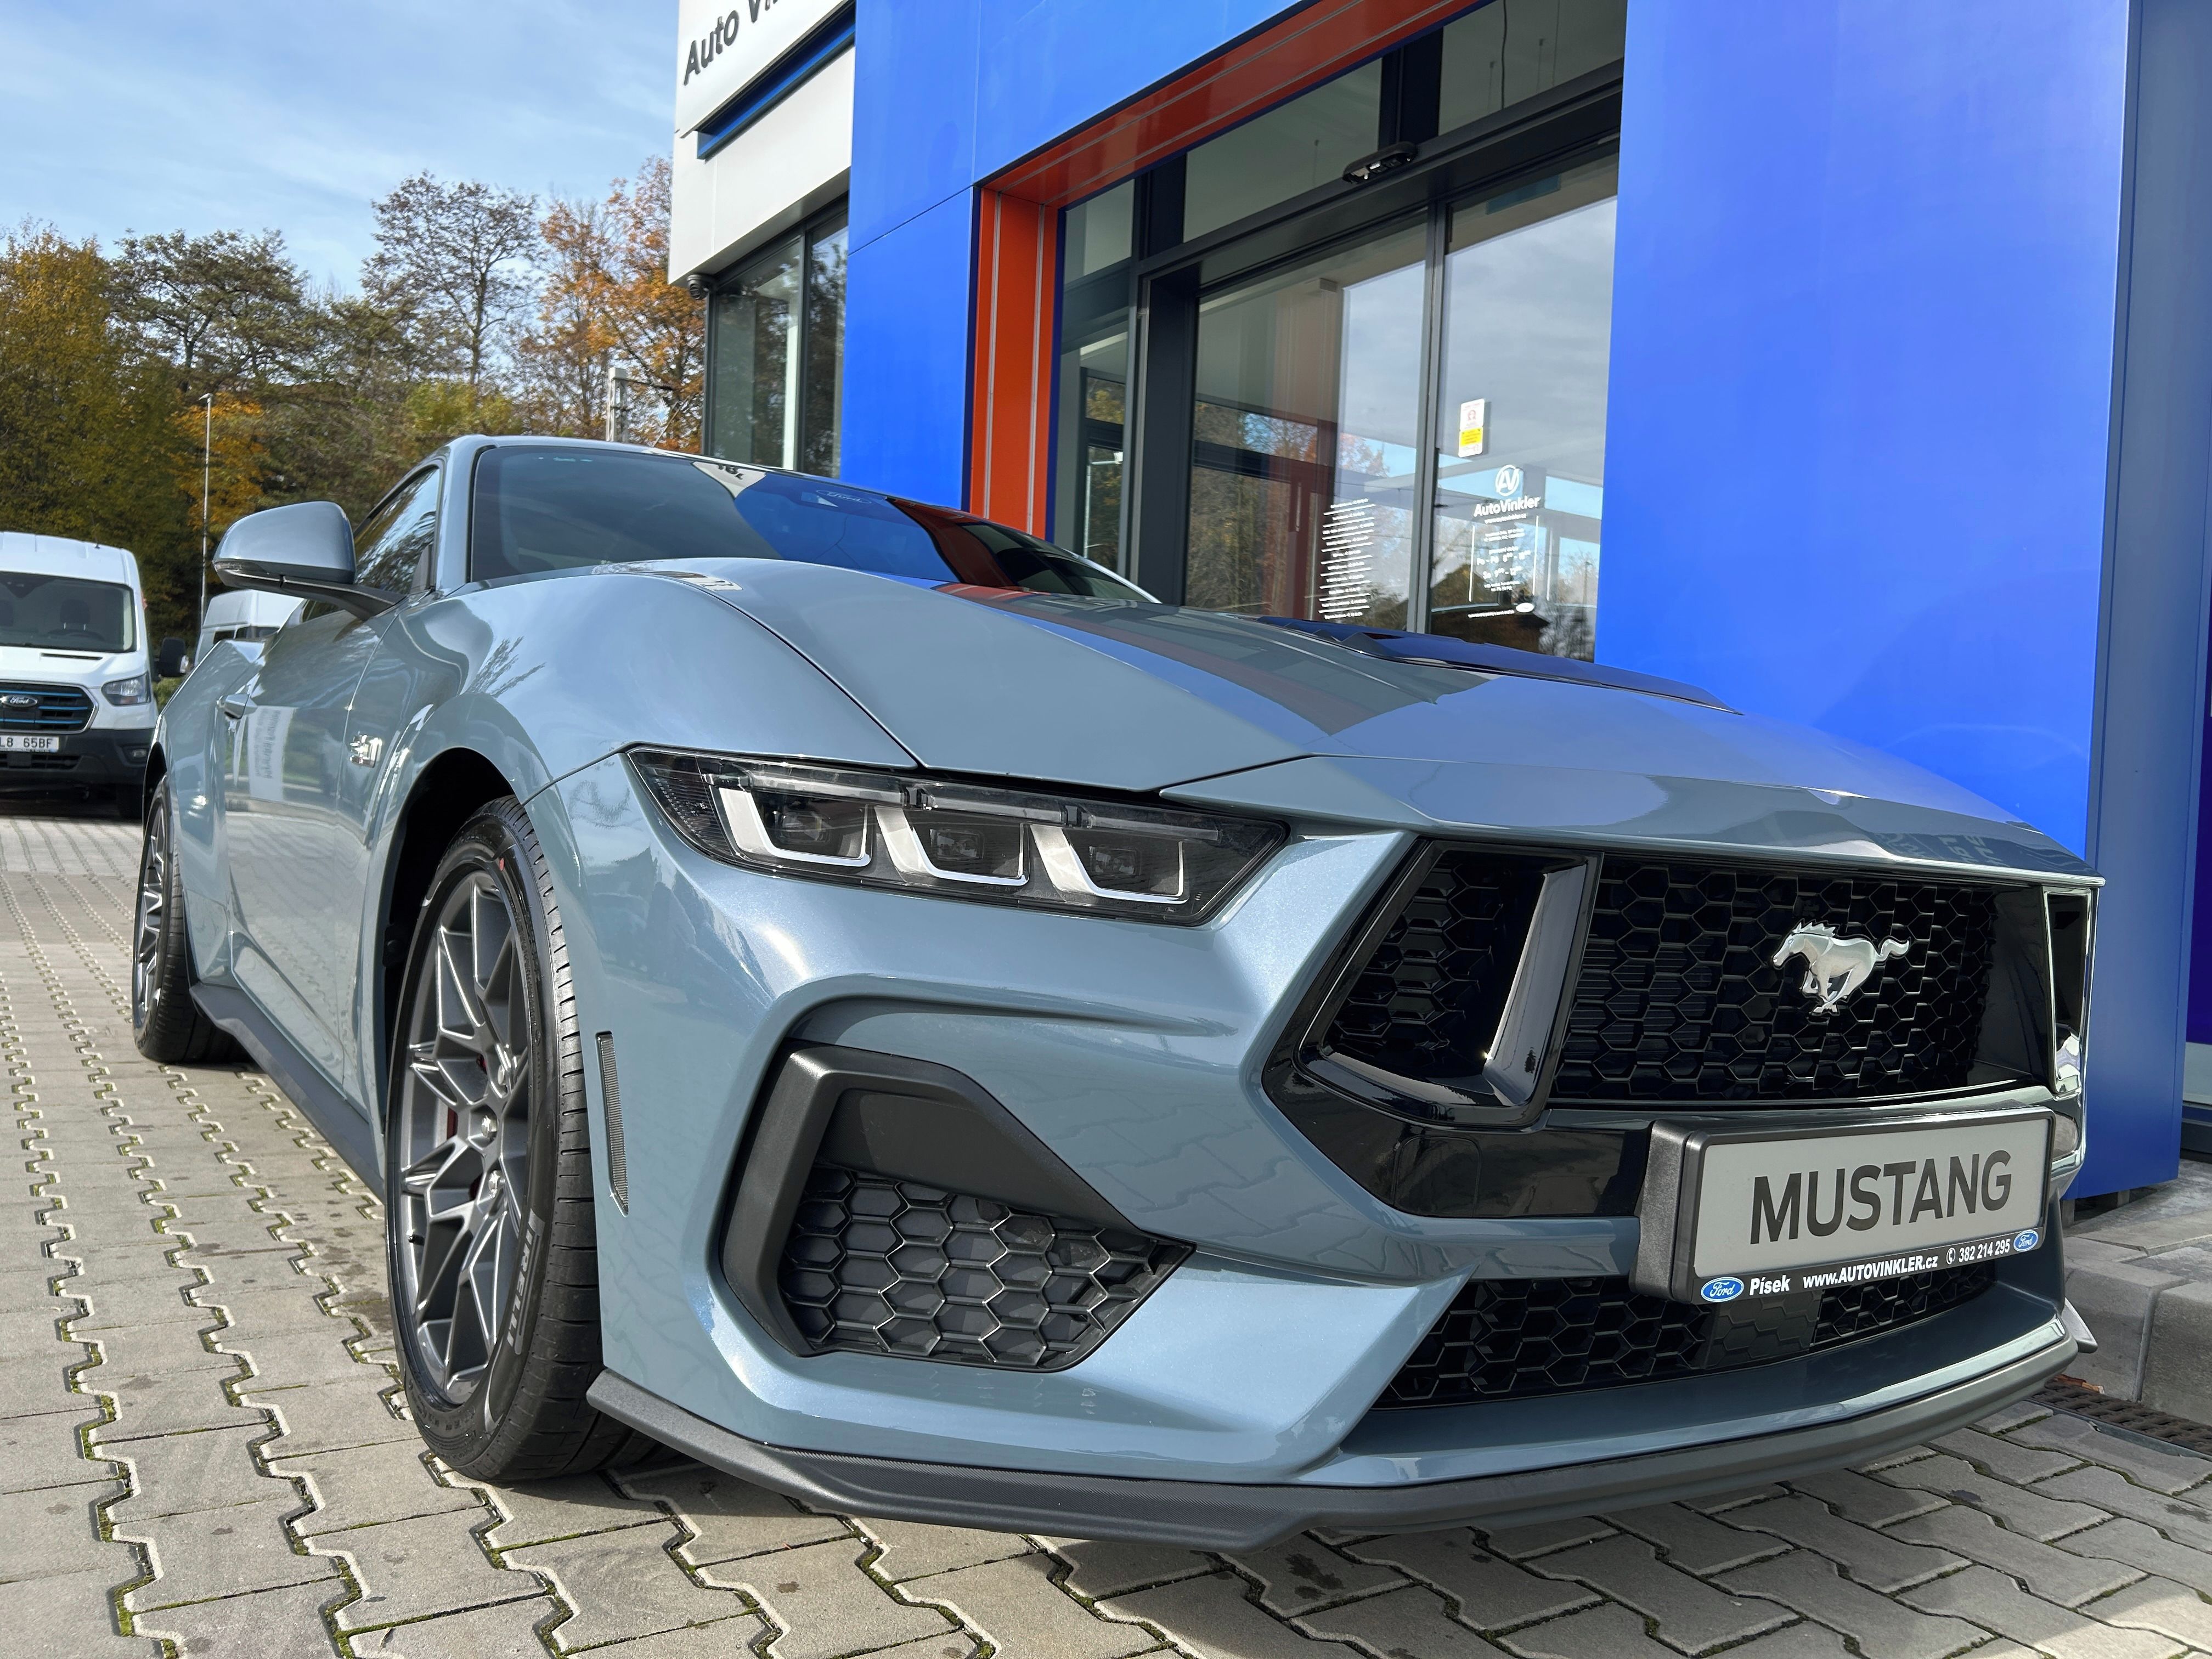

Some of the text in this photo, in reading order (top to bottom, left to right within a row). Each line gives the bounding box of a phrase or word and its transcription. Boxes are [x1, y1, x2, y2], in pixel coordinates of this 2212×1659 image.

[684, 10, 740, 86] Auto
[1474, 495, 1541, 517] AutoVinkler
[10, 695, 29, 704] Ford
[23, 737, 53, 748] 65BF
[1750, 1150, 2011, 1244] MUSTANG
[506, 1207, 546, 1355] PIRELLI
[1709, 1234, 2033, 1297] Ford Písek www.AUTOVINKLER.cz 382 214 295 Ford
